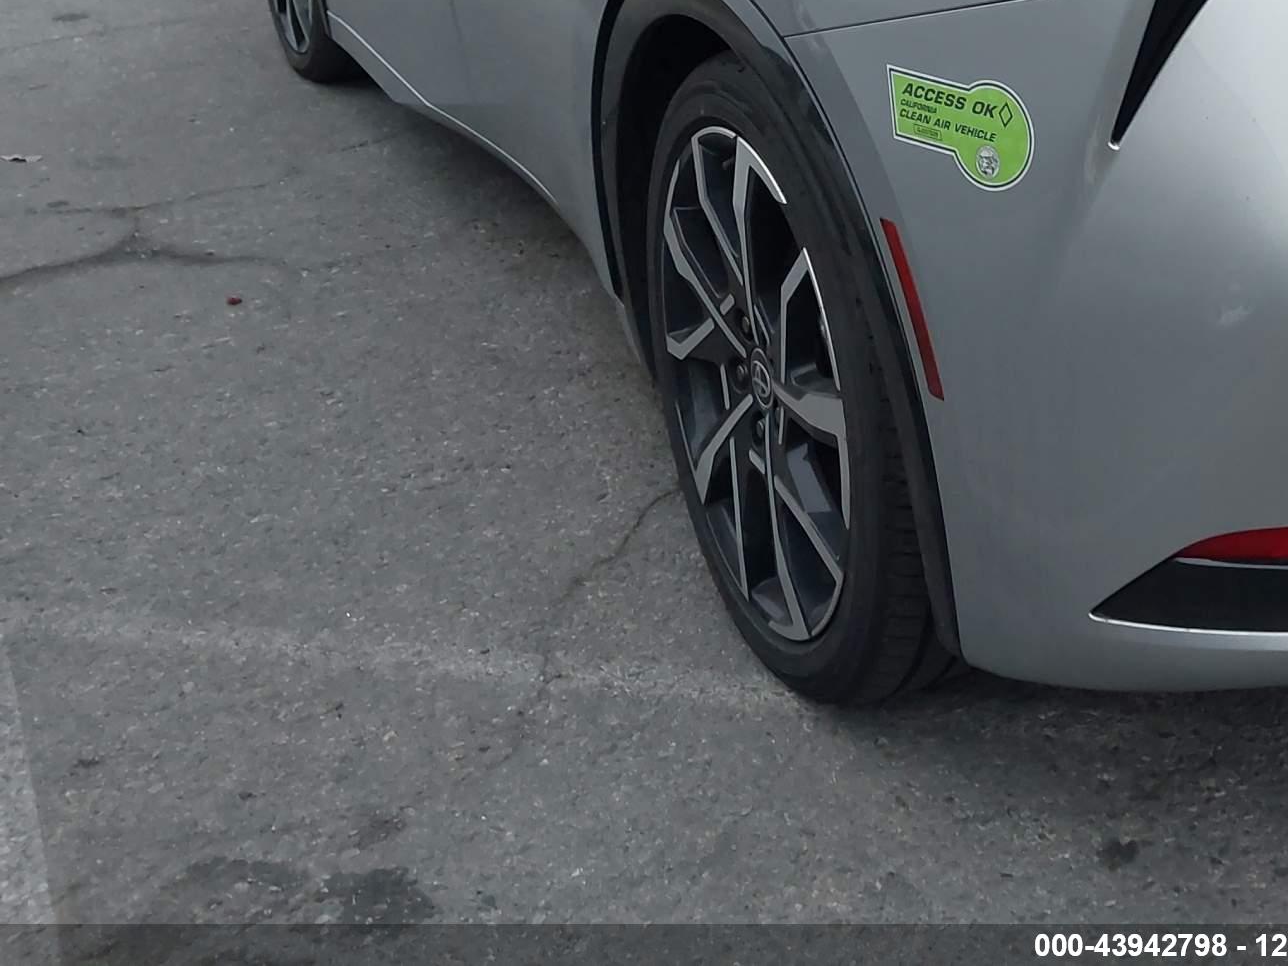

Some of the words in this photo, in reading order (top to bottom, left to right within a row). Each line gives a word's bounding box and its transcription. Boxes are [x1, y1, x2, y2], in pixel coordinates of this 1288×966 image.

[900, 98, 937, 114] CALIFORNIA
[901, 82, 967, 110] ACCESS
[971, 100, 998, 118] OK
[899, 108, 931, 125] CLEAN
[934, 118, 951, 131] AIR
[954, 123, 998, 142] VEHICLE
